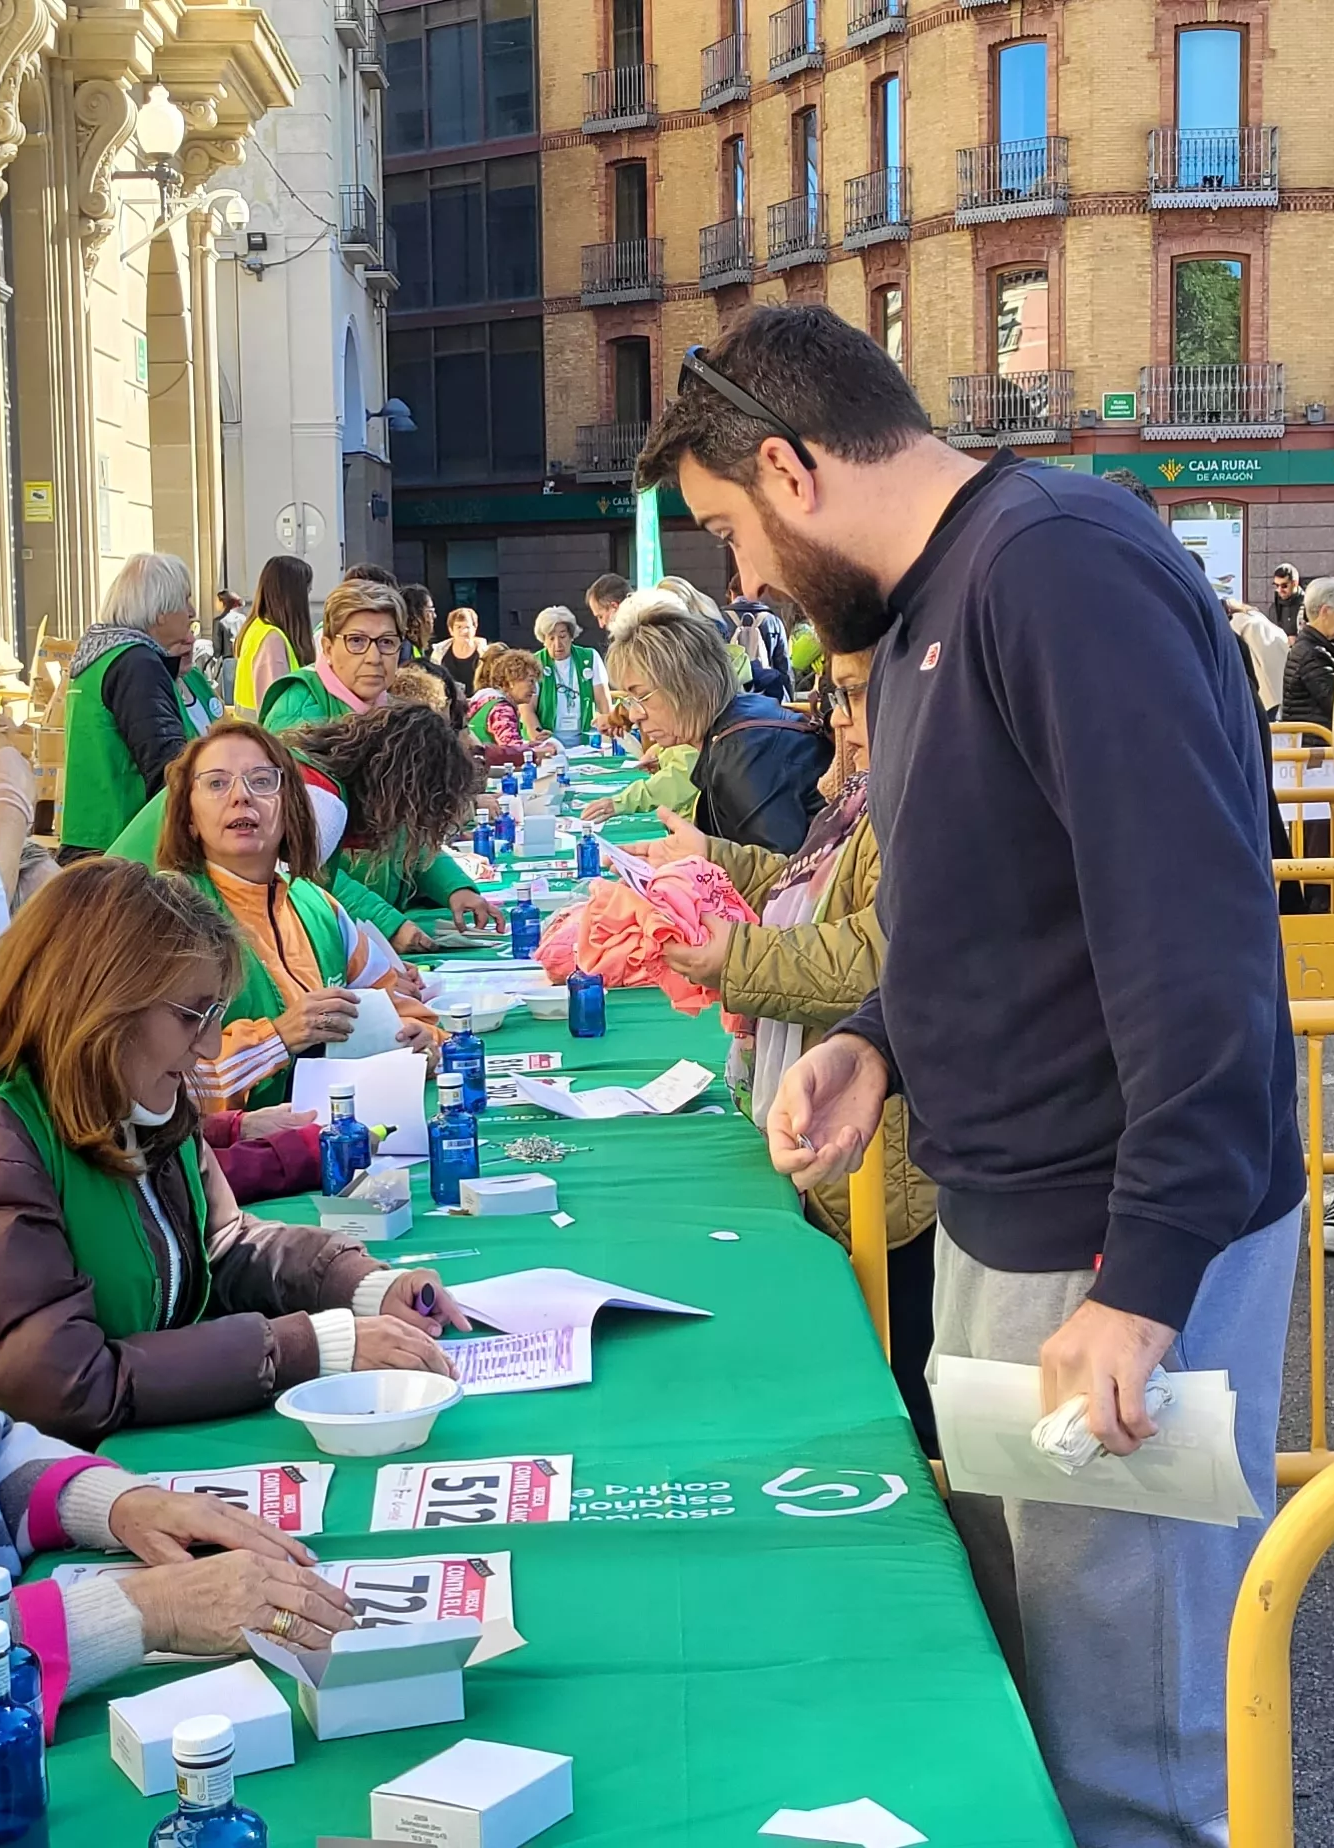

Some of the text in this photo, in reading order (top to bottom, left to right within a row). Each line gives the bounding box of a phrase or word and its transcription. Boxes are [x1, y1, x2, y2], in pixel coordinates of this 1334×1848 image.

[1189, 459, 1261, 471] CAJA RURAL
[1197, 472, 1253, 481] DE ARAGÓN
[514, 1465, 532, 1494] CONTRA
[605, 1481, 731, 1496] contra
[424, 1475, 501, 1527] 512
[444, 1565, 466, 1598] CONTRA
[443, 1598, 462, 1608] EL
